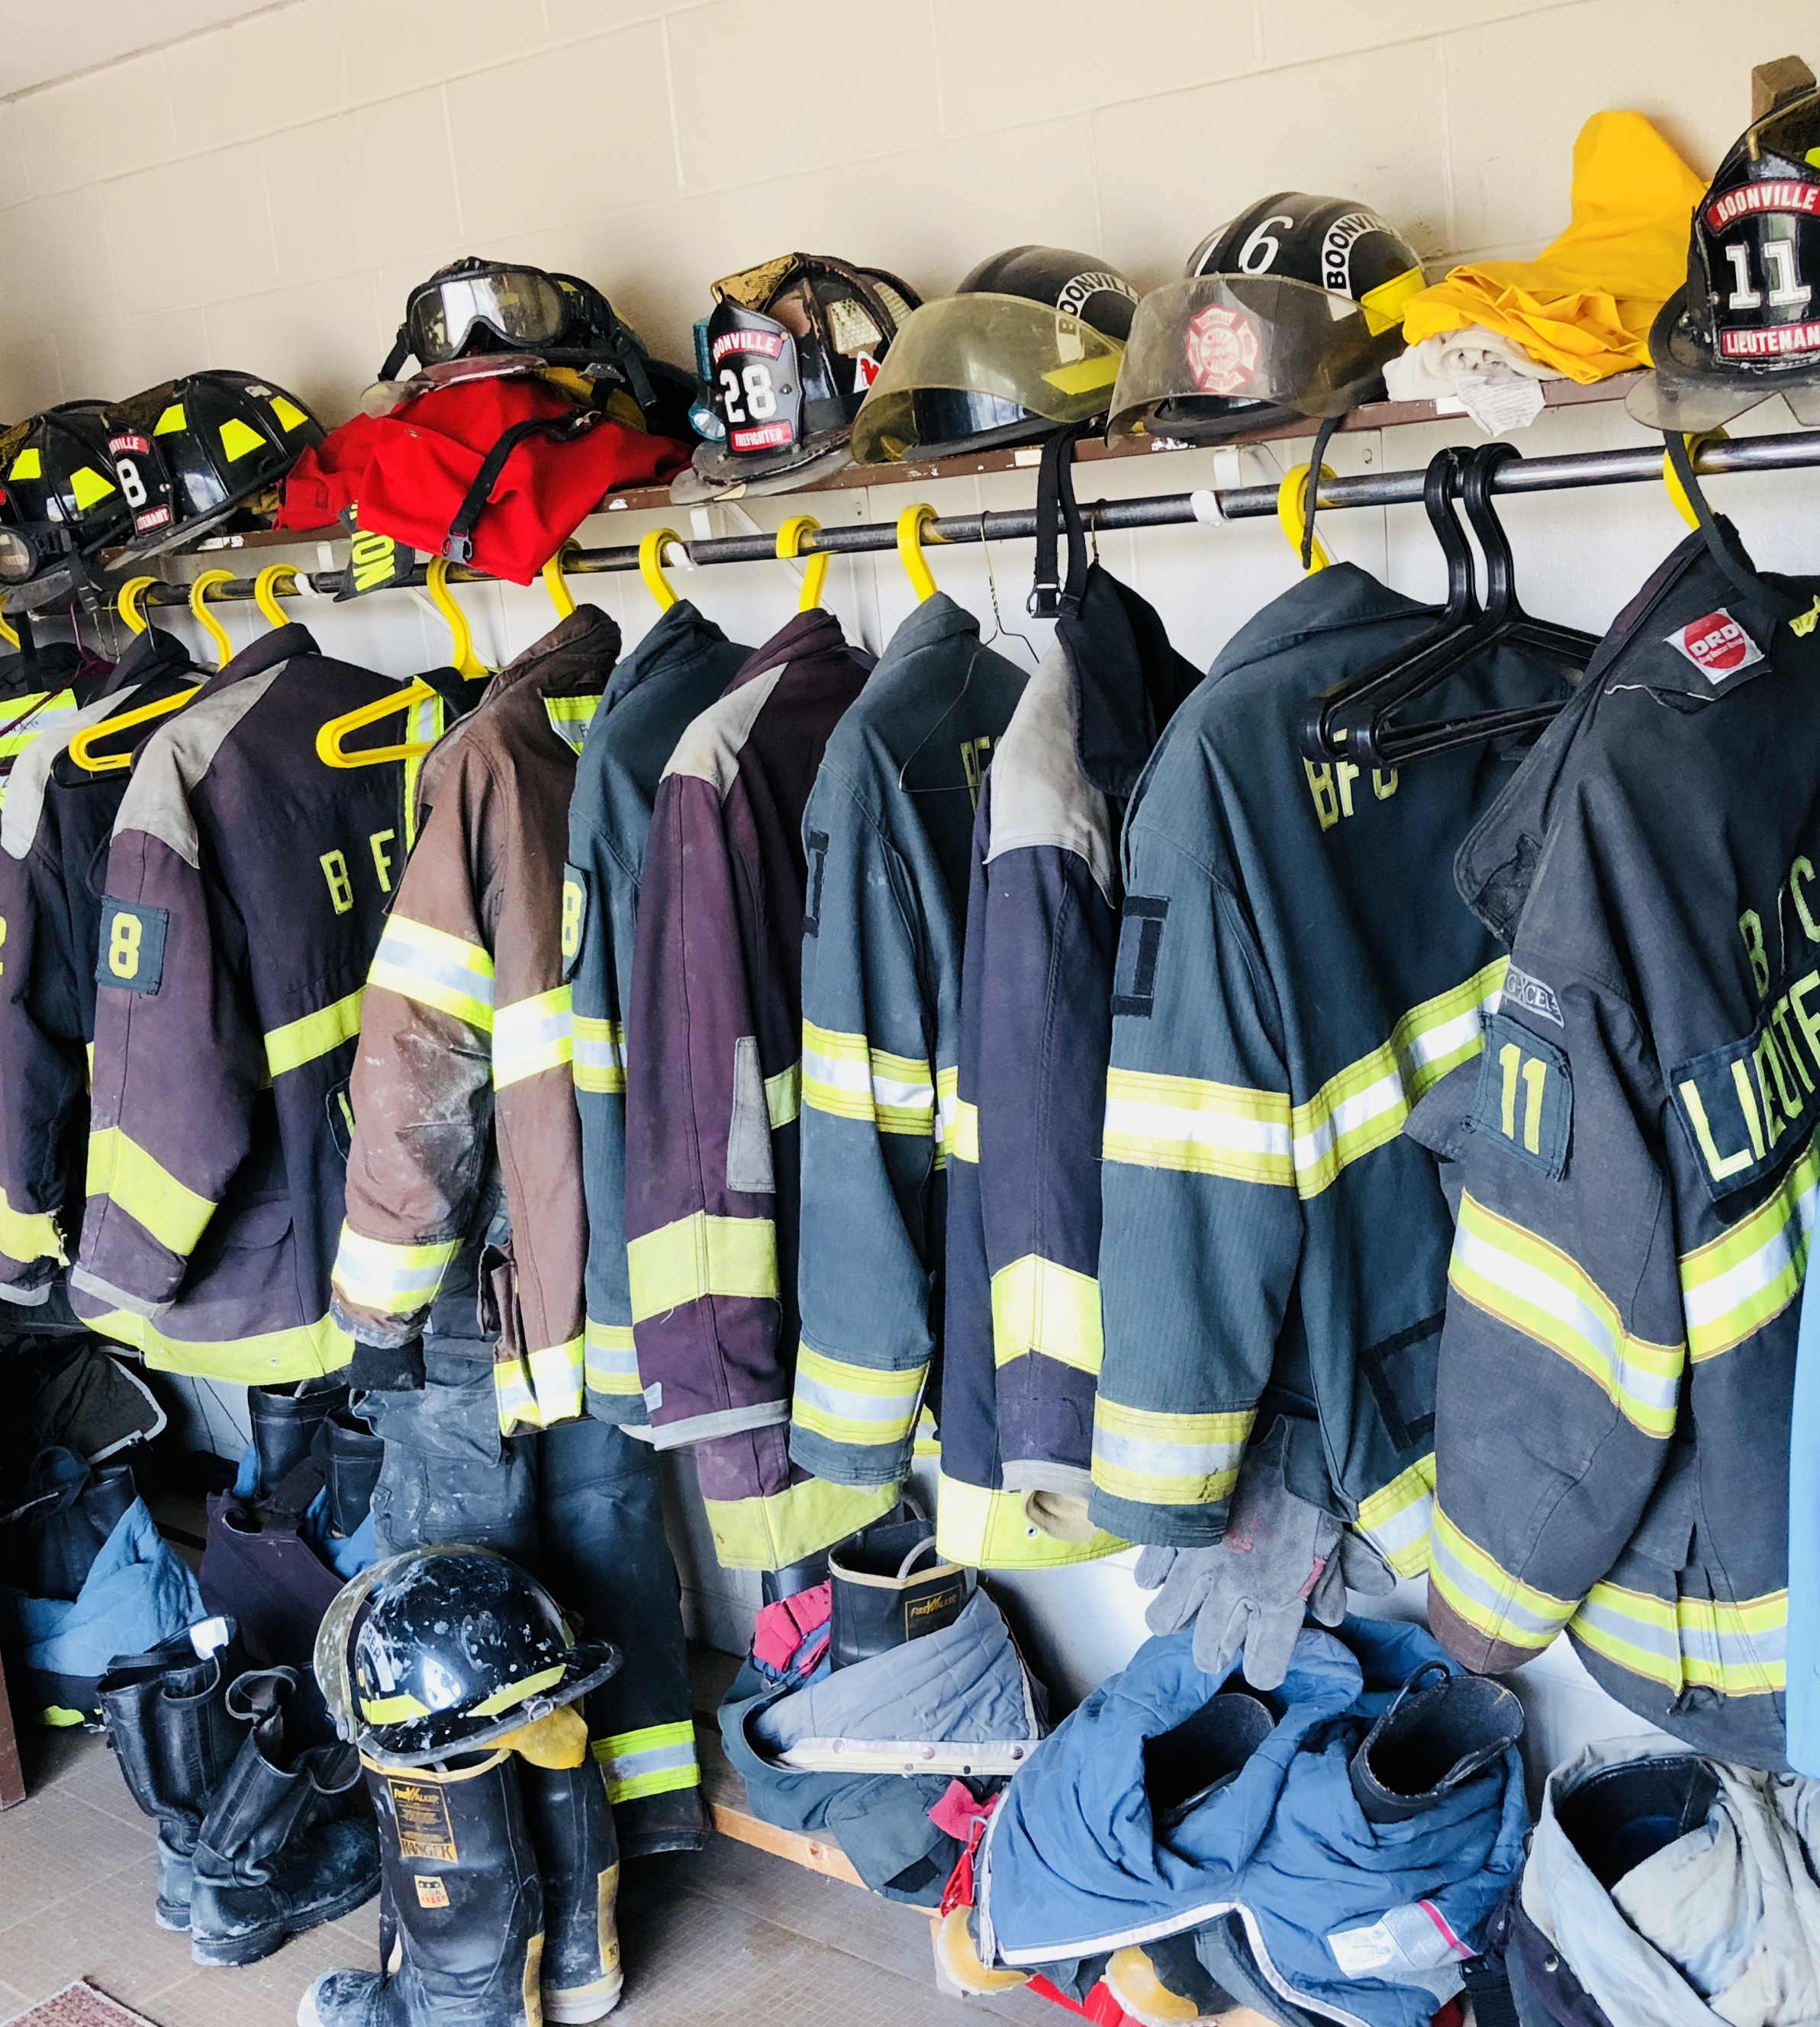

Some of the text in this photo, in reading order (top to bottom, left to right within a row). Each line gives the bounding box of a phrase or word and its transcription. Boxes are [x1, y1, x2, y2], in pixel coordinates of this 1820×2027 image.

[1717, 184, 1818, 222] BOONVILLE
[1193, 216, 1294, 276] 16
[1725, 240, 1812, 309] 11
[720, 363, 777, 423] 28
[735, 427, 783, 447] FIREFIGHTER
[116, 458, 147, 508] 8
[1689, 624, 1740, 657] DRD
[108, 912, 143, 979] 8
[1499, 1043, 1548, 1155] 11
[401, 1840, 453, 1861] RANGER
[420, 1887, 442, 1896] USA
